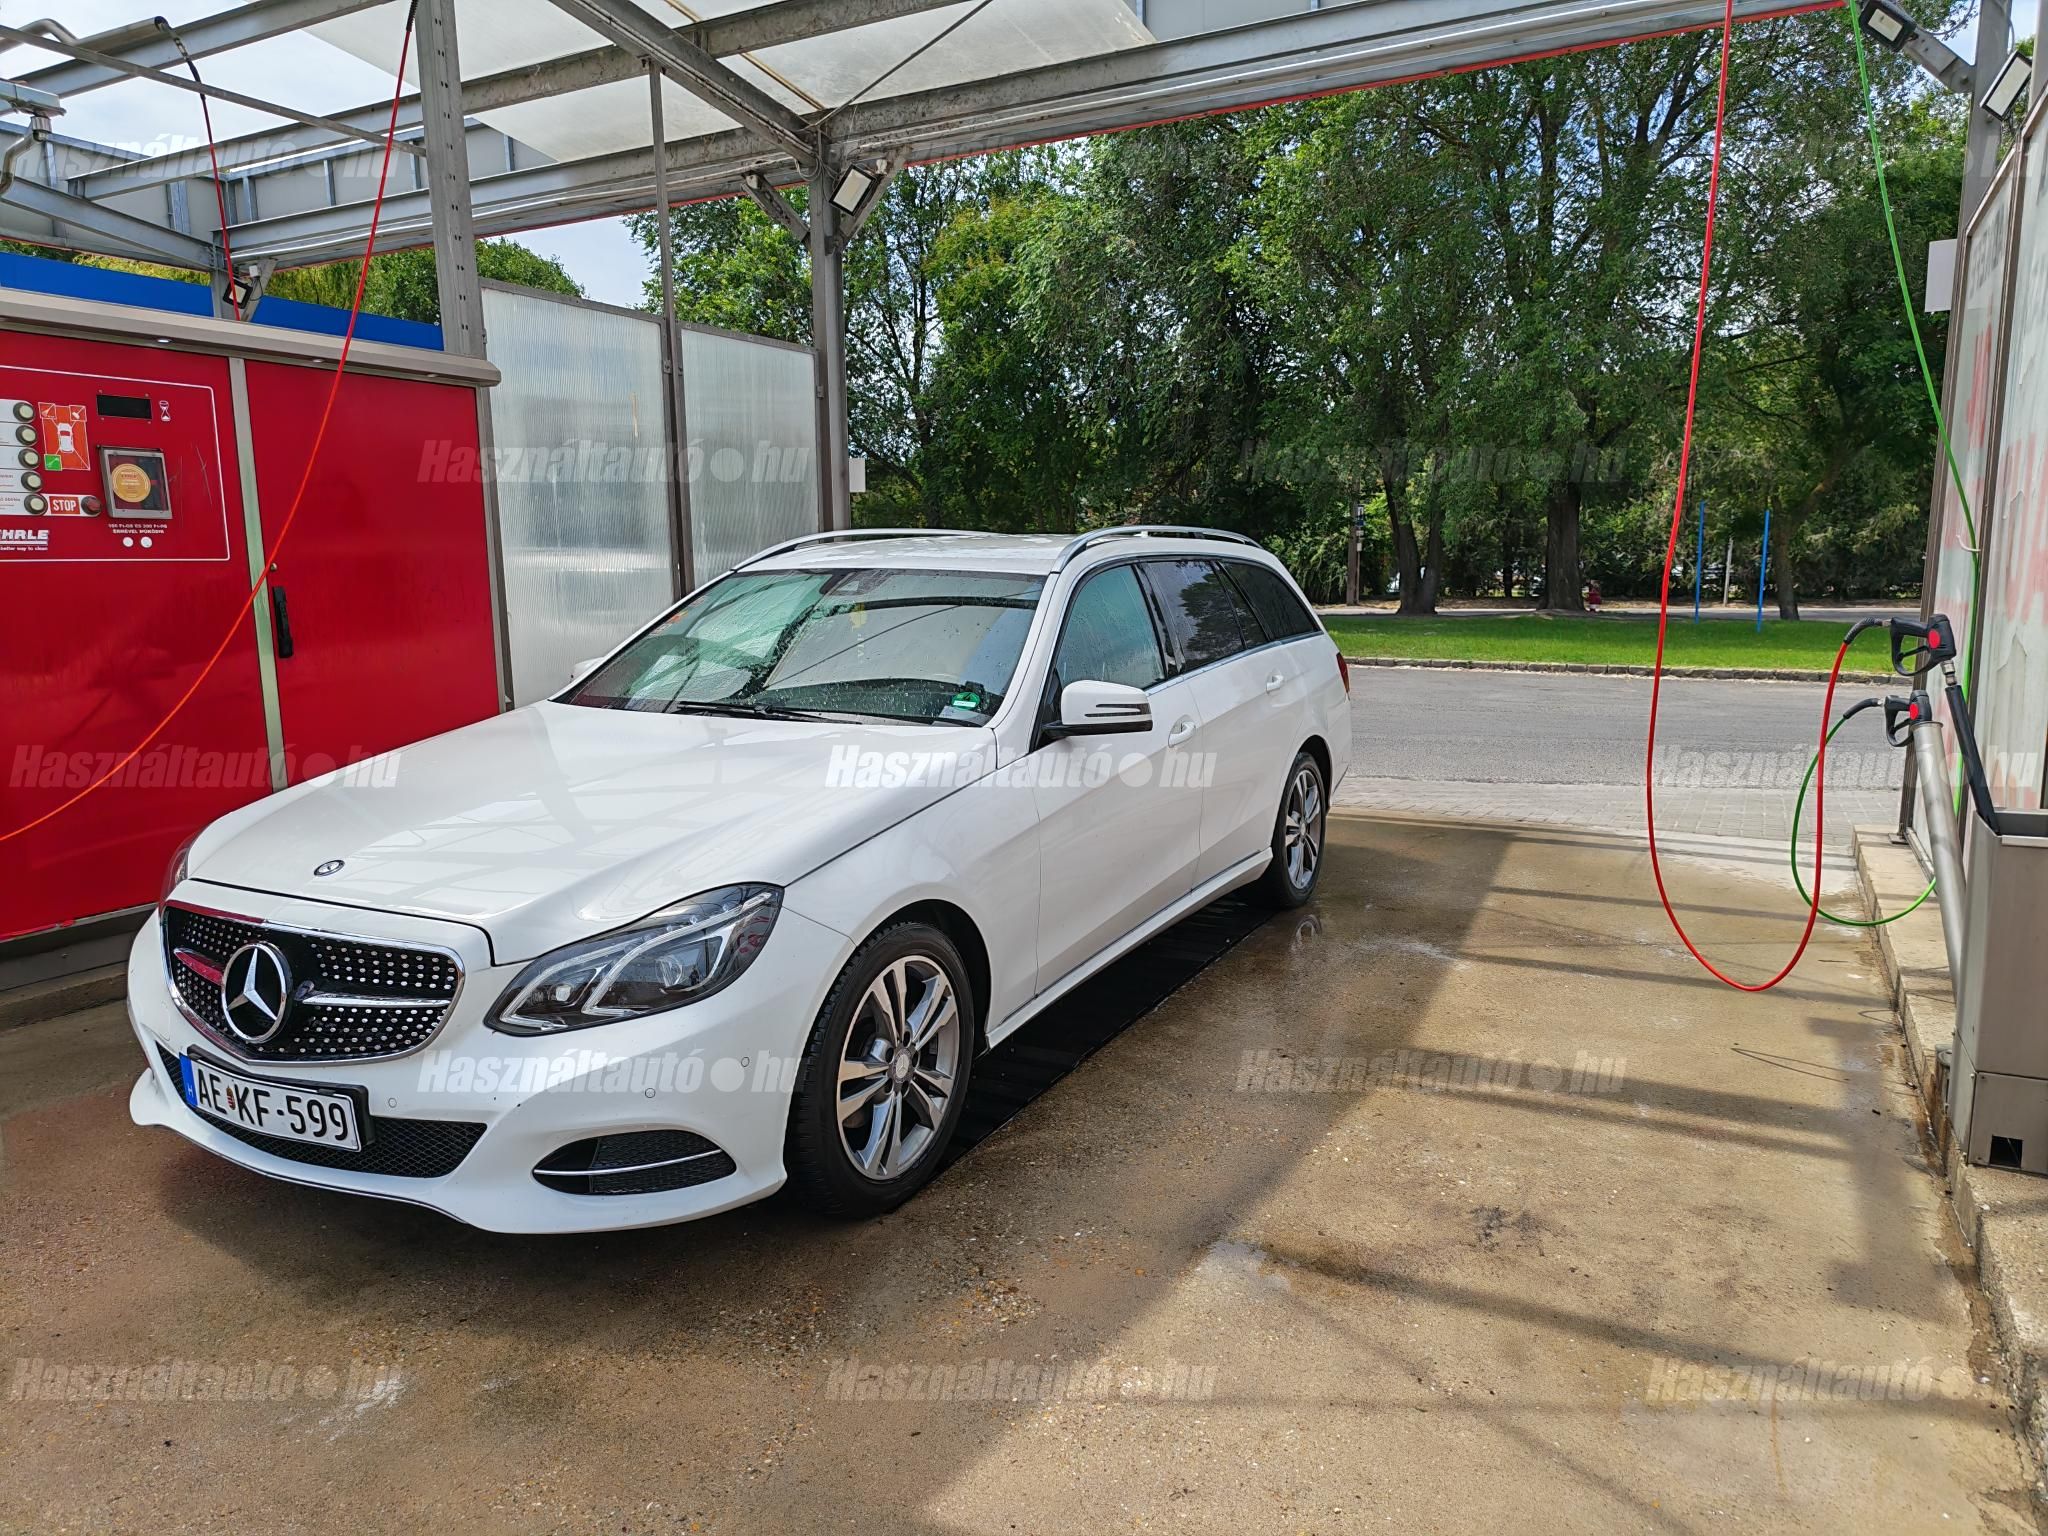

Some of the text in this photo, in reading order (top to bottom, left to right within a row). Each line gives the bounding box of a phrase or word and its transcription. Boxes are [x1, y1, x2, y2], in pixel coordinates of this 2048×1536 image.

[53, 500, 76, 511] STOP
[0, 530, 49, 539] HRLE
[198, 1068, 227, 1115] AE
